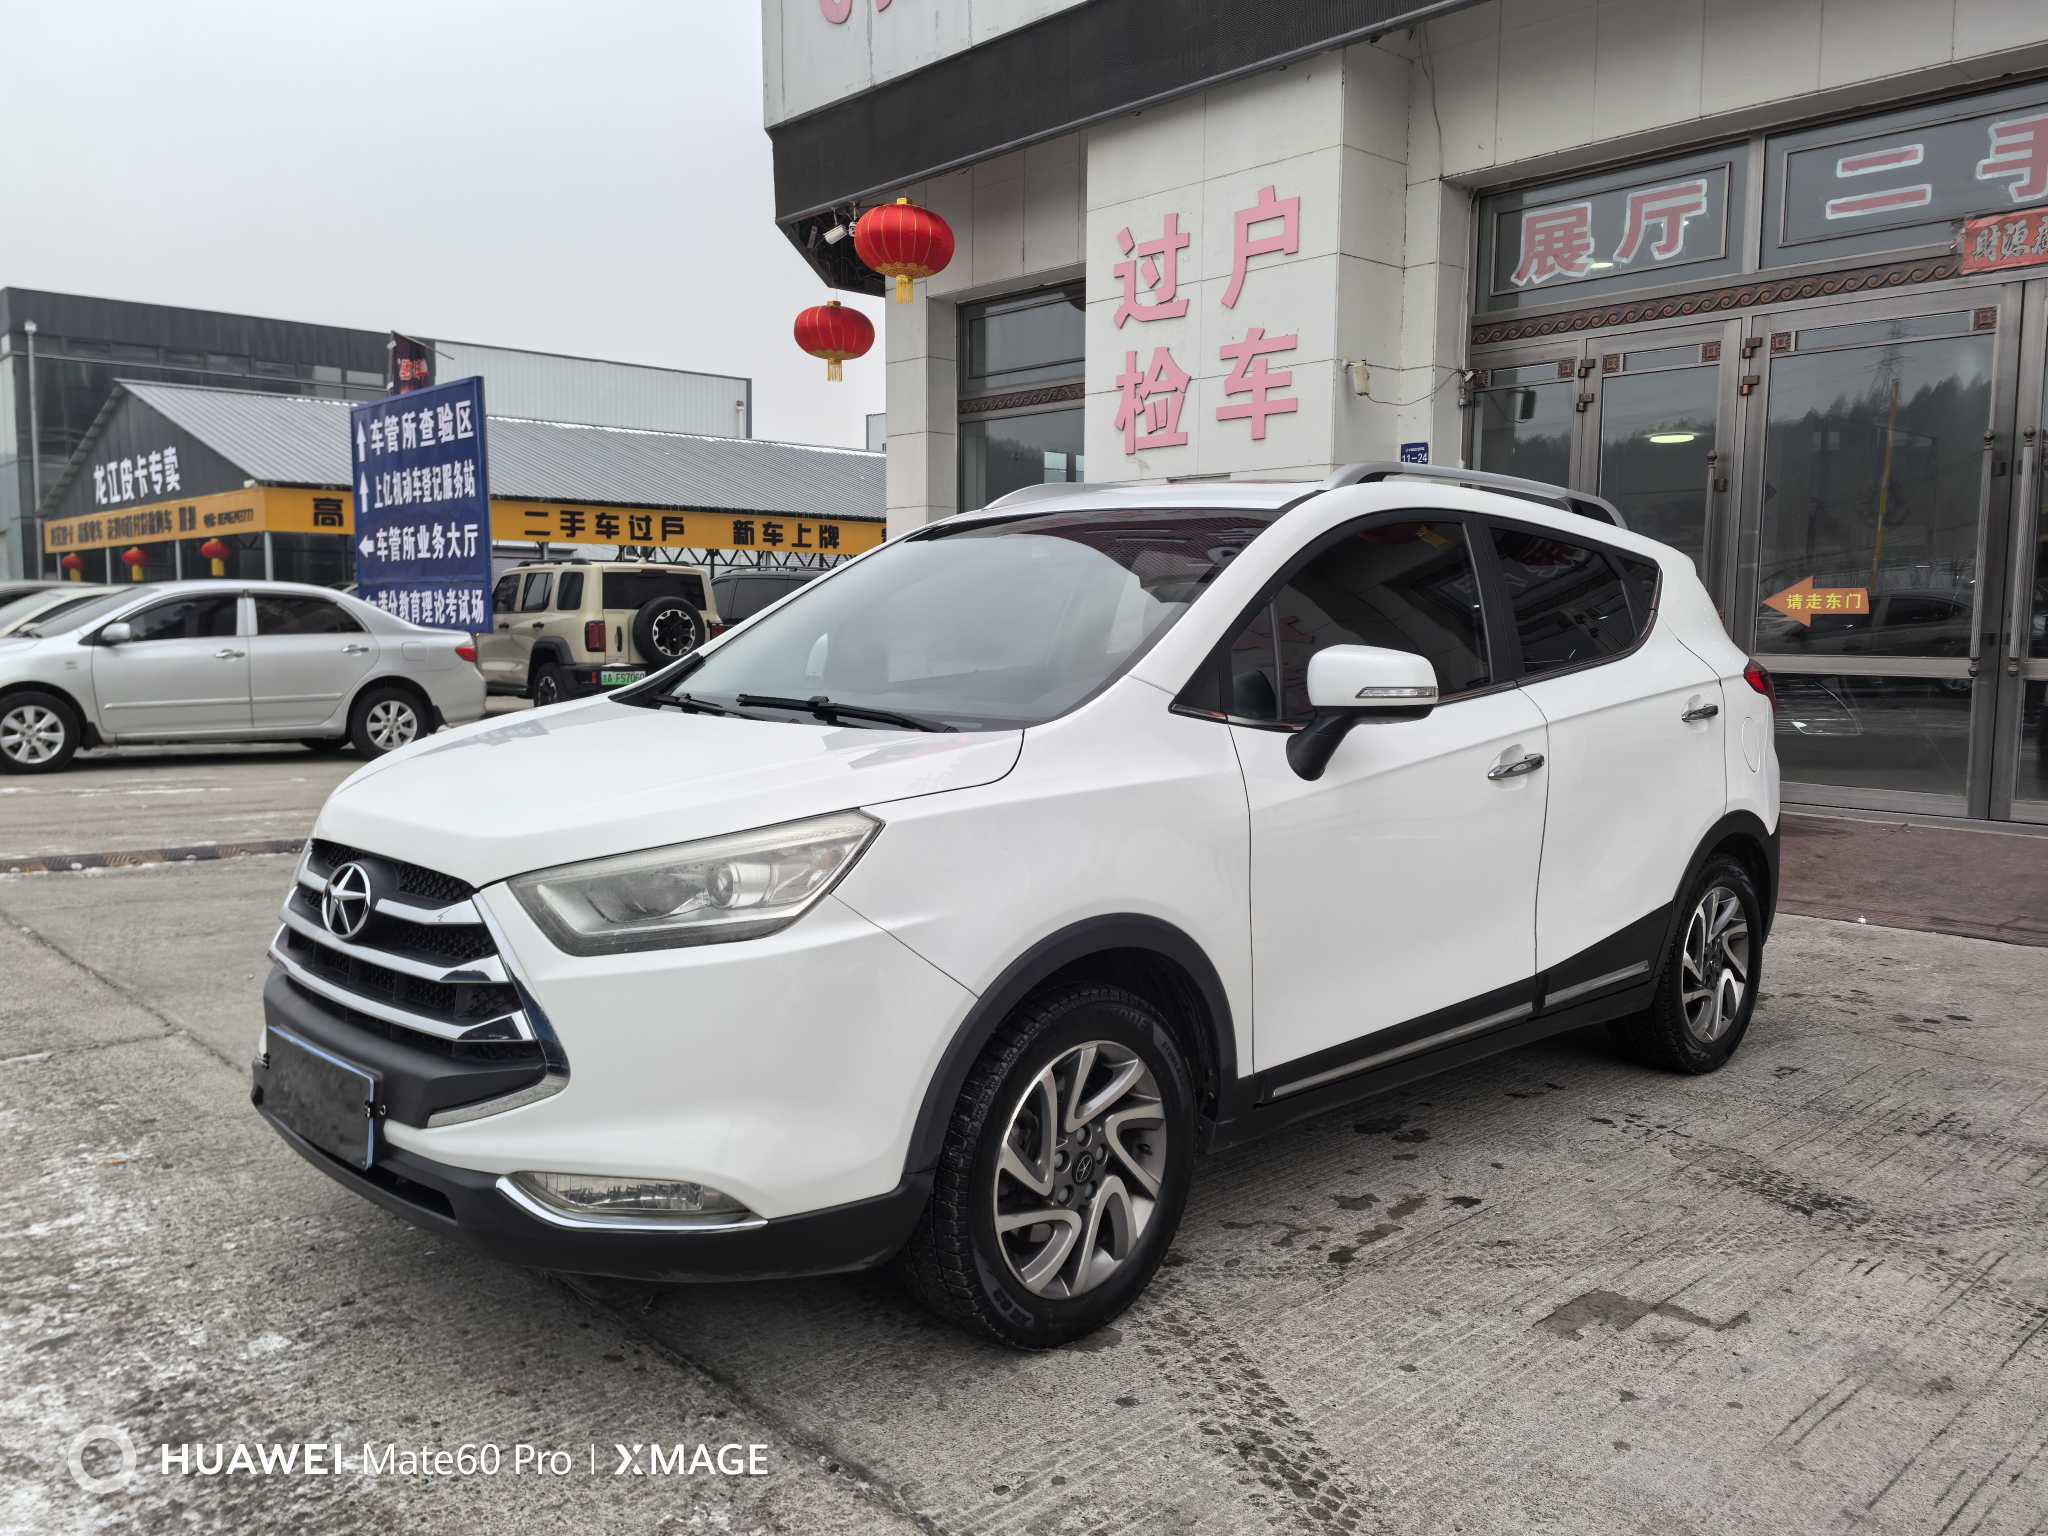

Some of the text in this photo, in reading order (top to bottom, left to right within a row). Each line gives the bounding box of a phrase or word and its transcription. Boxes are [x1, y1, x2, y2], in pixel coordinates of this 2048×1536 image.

[1113, 185, 1300, 330] 过户
[1510, 178, 1708, 287] 展厅
[1113, 328, 1299, 456] 检车
[369, 400, 474, 456] 车管所查验区
[93, 446, 181, 504] 龙江皮卡专卖
[374, 459, 476, 509] 上亿机动车登记服务站
[376, 522, 479, 562] 车管所业务大厅
[524, 510, 840, 550] 二手车过户 新车上牌
[1786, 593, 1862, 609] 请走东门
